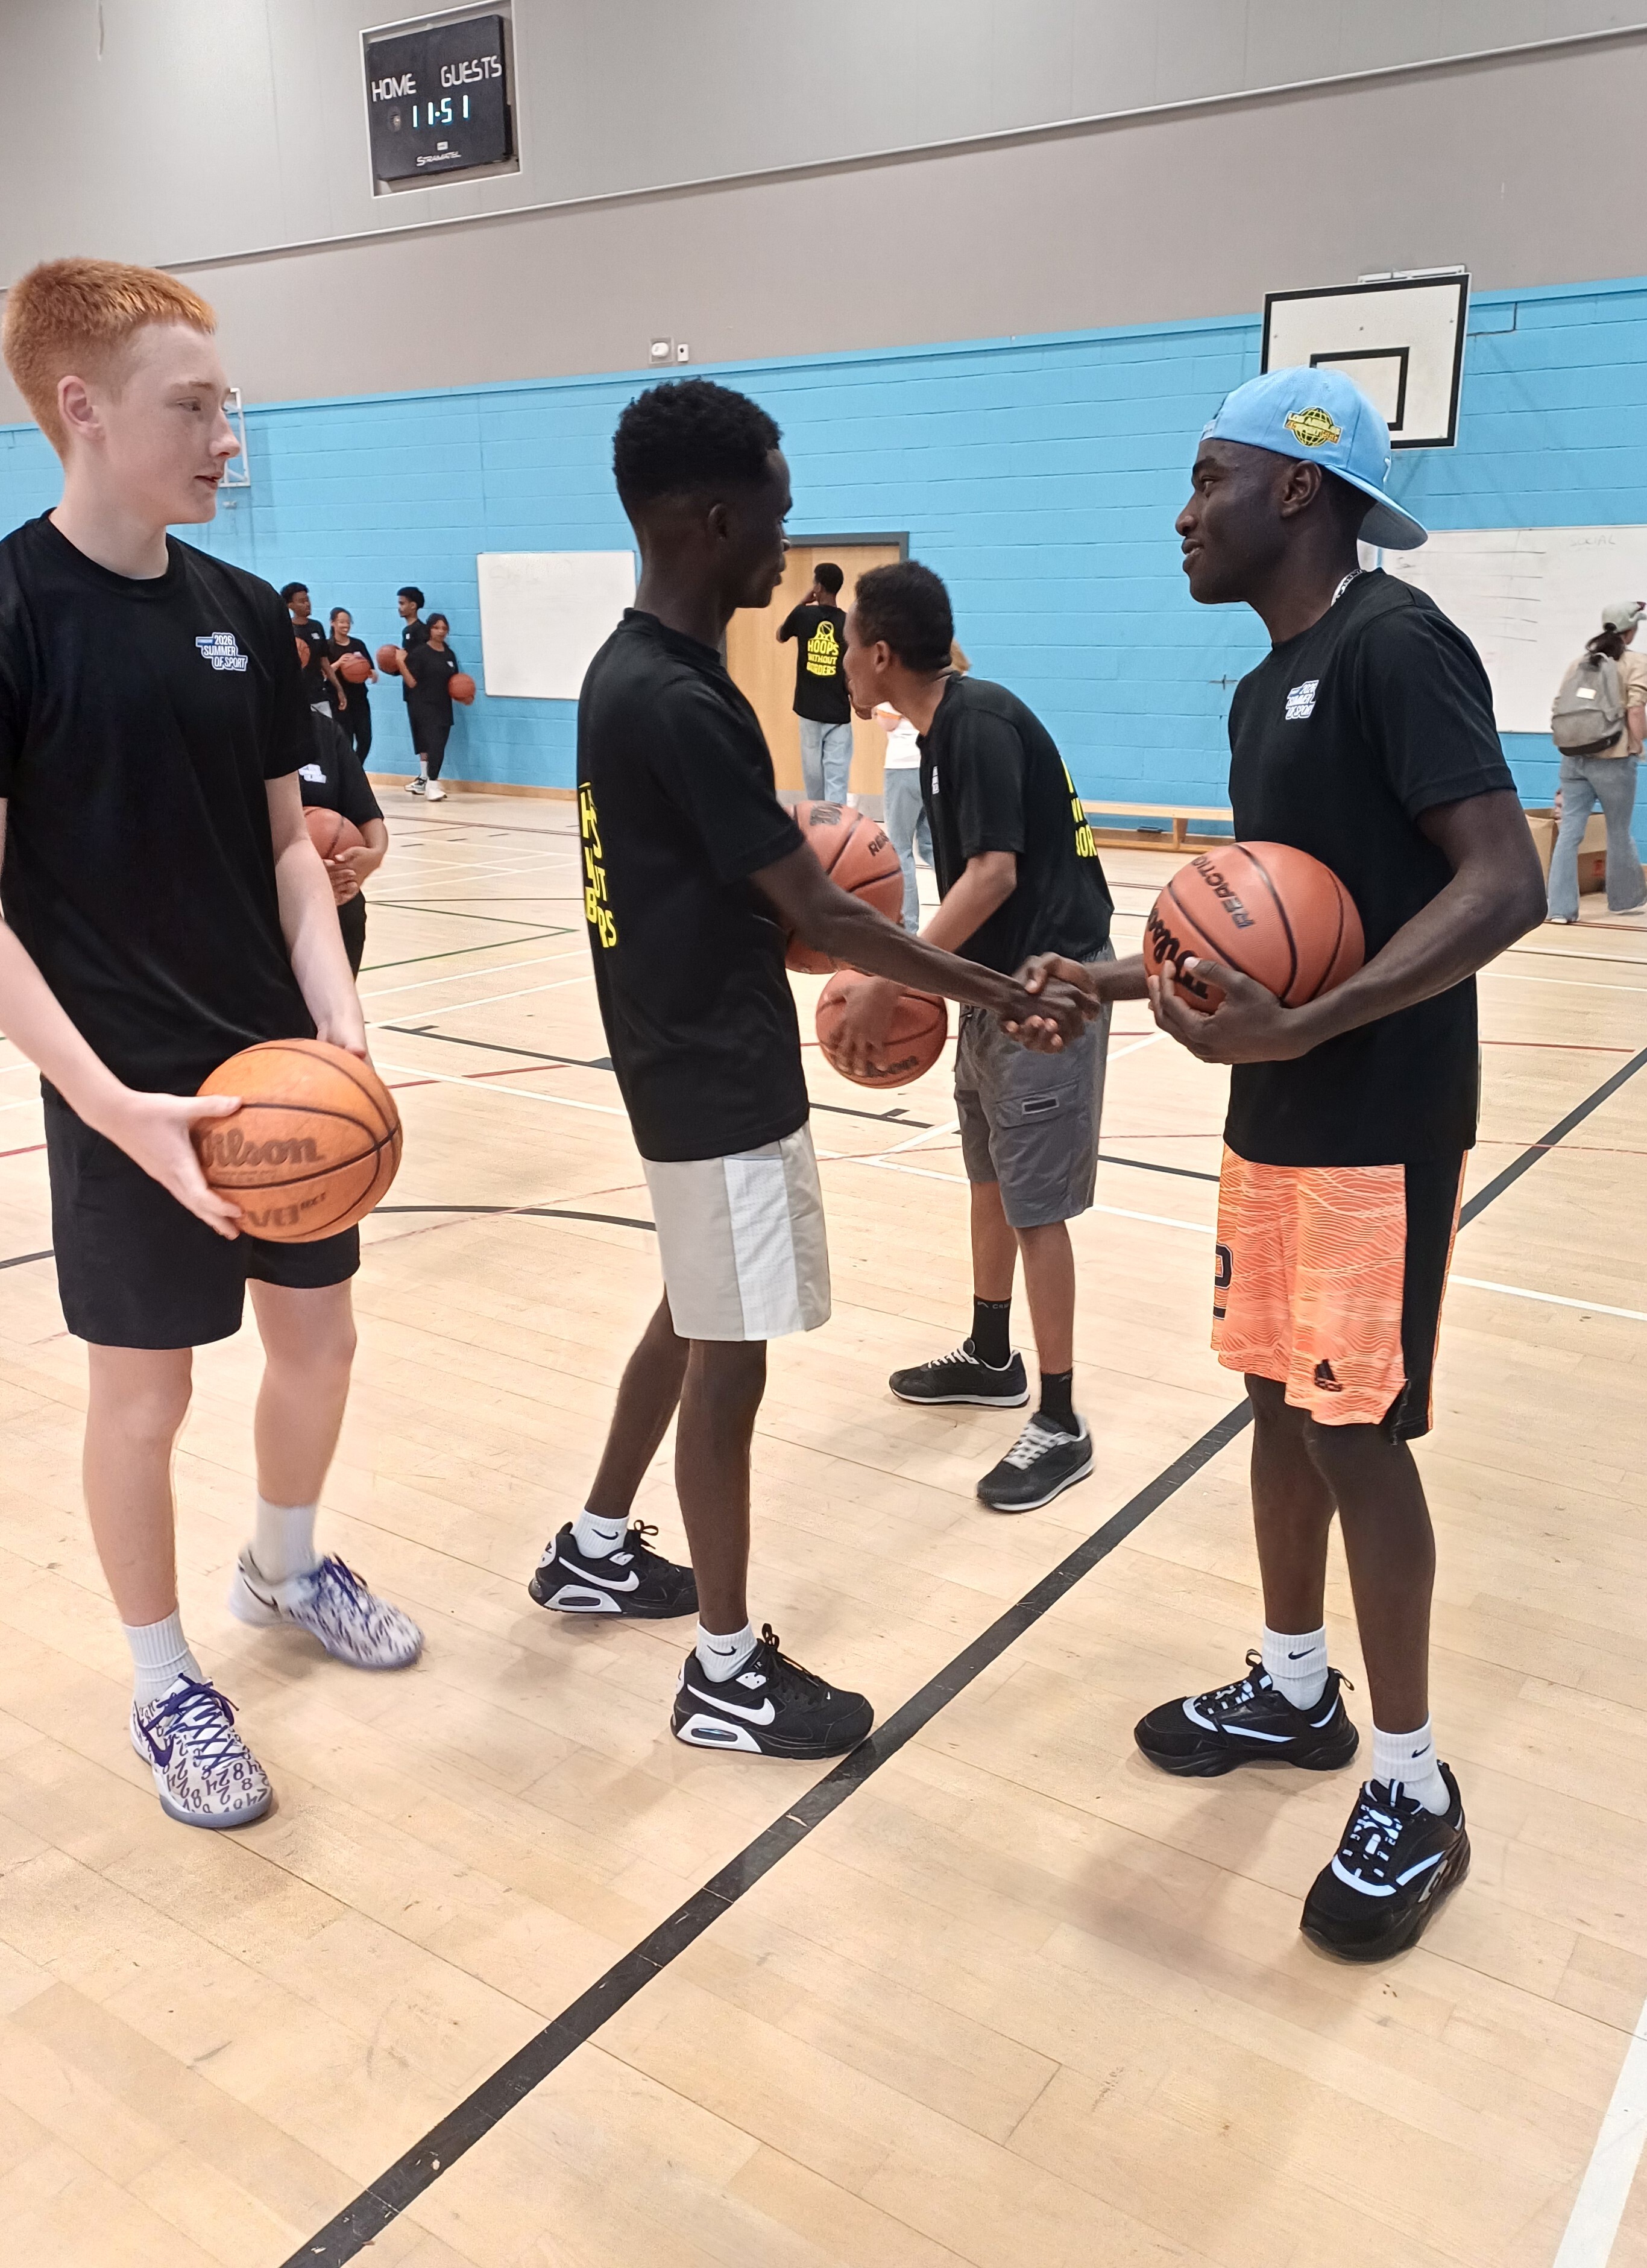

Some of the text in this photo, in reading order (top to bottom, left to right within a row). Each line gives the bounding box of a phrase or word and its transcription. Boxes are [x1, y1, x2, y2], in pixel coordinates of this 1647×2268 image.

[372, 55, 503, 102] HOME GUESTS
[214, 634, 233, 645] 2026
[204, 645, 236, 657] SUMMER
[807, 639, 839, 656] HOOPS
[214, 657, 245, 669] OF SPORT
[807, 653, 837, 665] WITHOUT
